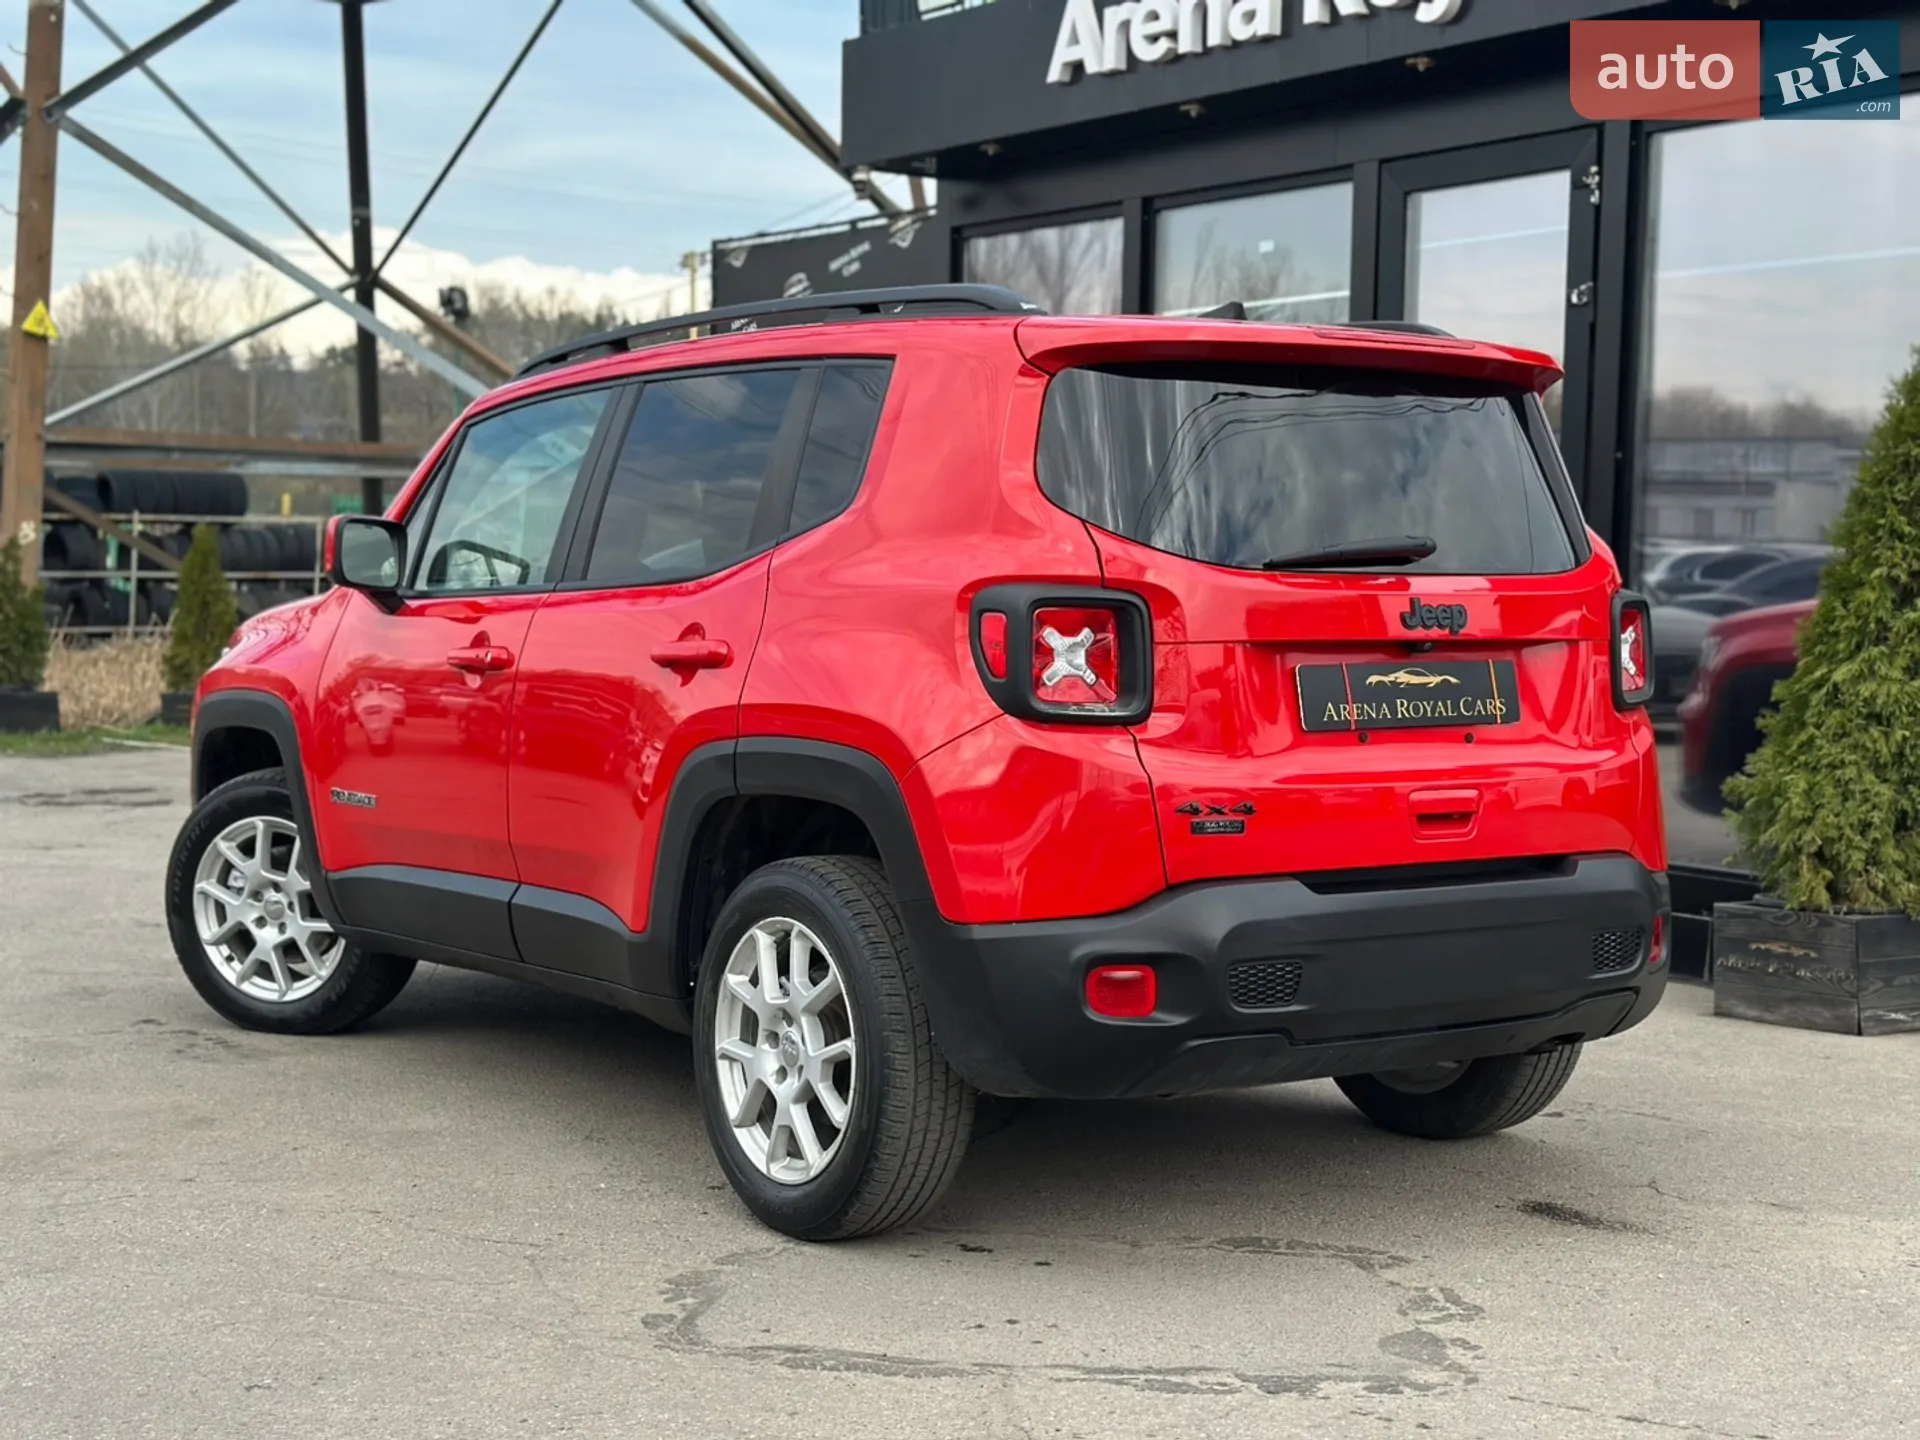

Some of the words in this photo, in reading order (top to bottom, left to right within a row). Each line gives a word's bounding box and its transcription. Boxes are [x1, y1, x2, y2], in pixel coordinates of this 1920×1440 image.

[1046, 0, 1282, 84] Arena
[1401, 597, 1467, 635] Jeep
[1322, 701, 1392, 722] ARENA
[1395, 698, 1457, 718] ROYAL
[1459, 696, 1507, 716] CARS
